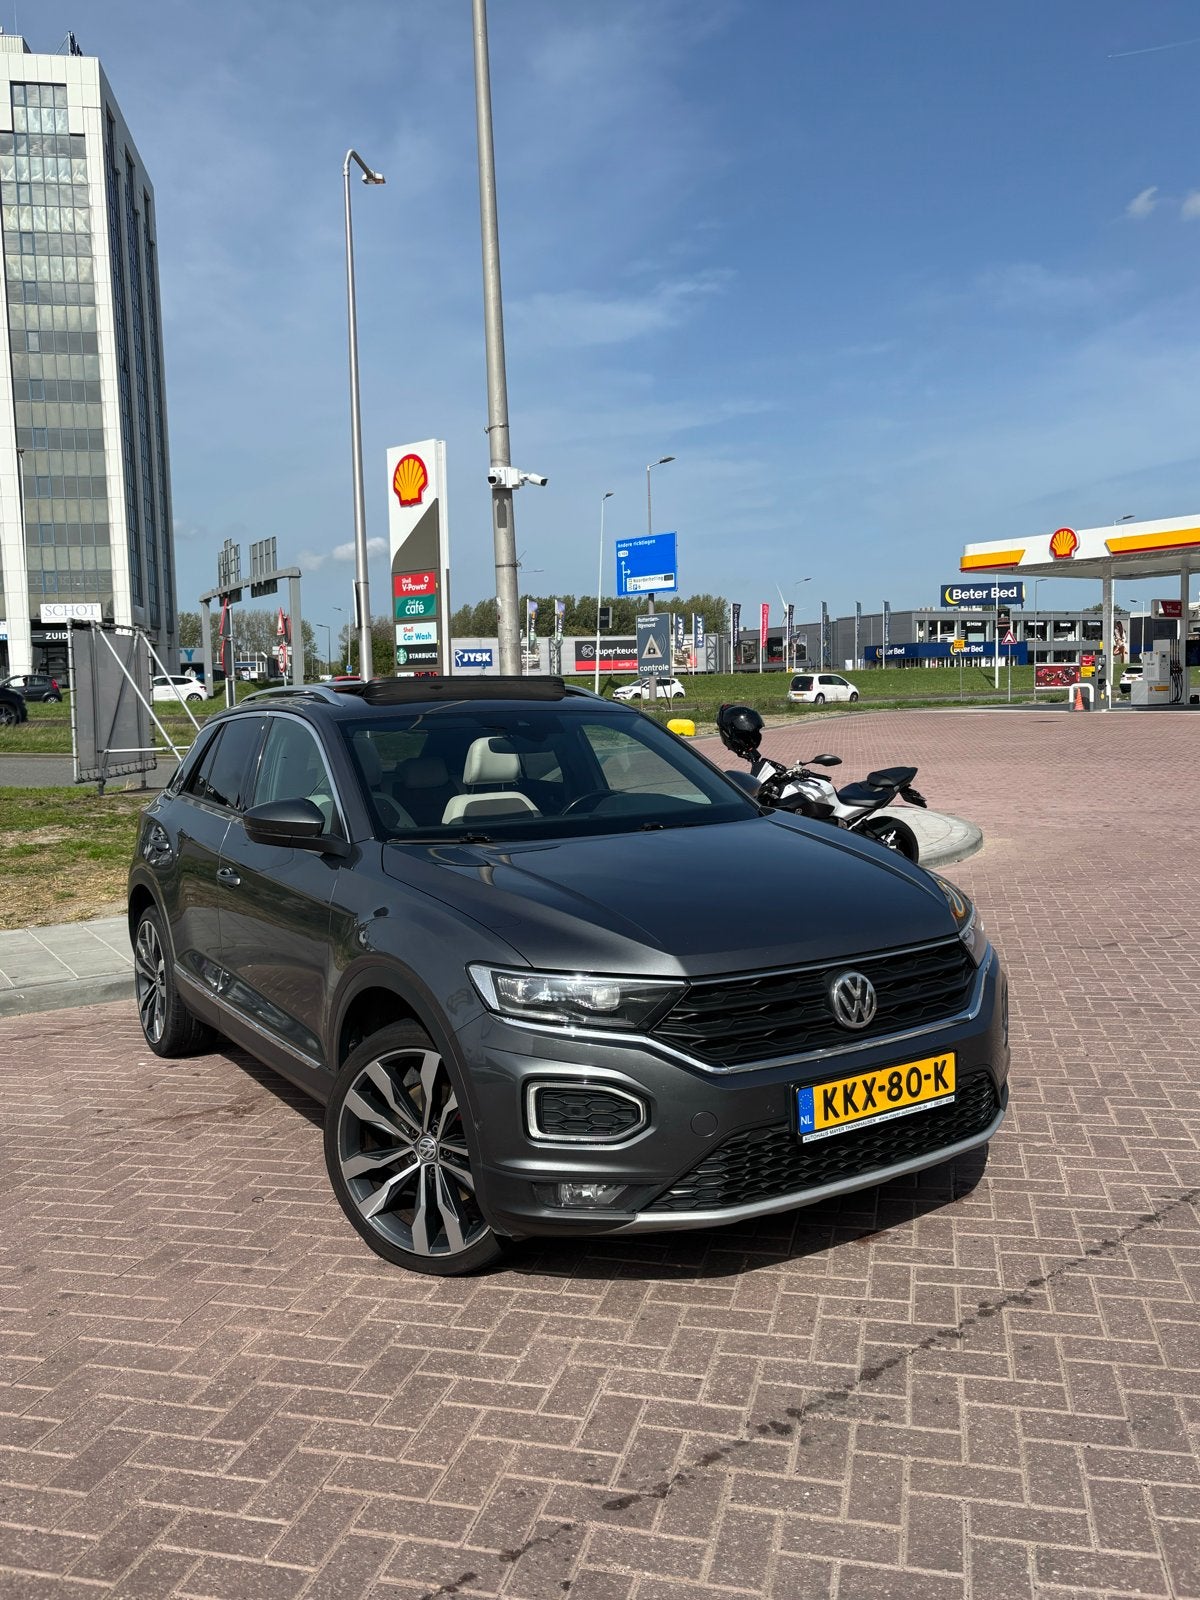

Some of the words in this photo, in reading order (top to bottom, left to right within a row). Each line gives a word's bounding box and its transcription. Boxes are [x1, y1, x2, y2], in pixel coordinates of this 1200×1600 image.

[402, 583, 428, 591] V-Power
[952, 588, 987, 600] Beter
[990, 586, 1018, 599] Bed
[45, 605, 97, 616] SCHOT
[405, 600, 425, 614] café
[403, 633, 414, 641] Car
[415, 632, 432, 640] Wash
[971, 645, 984, 653] Bed
[462, 651, 492, 662] JYSK
[639, 664, 670, 672] controle
[822, 1059, 950, 1122] KKX-80-K
[800, 1114, 813, 1125] NL
[804, 1130, 829, 1142] AUTOHAUS
[829, 1126, 845, 1136] MAYER
